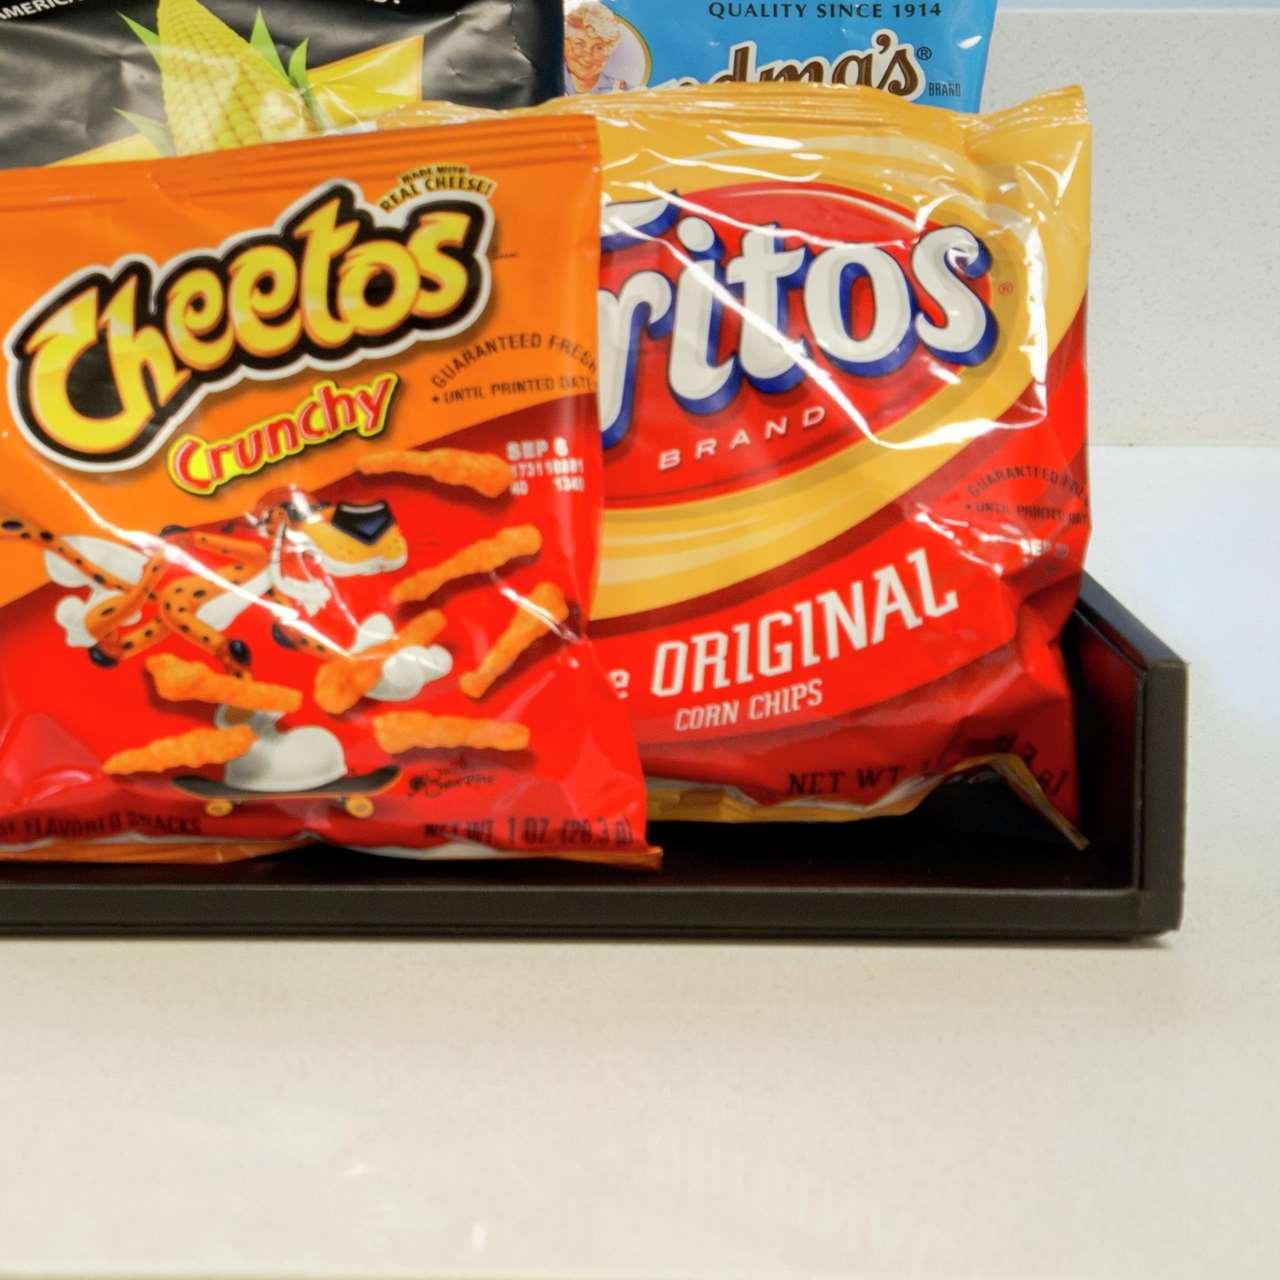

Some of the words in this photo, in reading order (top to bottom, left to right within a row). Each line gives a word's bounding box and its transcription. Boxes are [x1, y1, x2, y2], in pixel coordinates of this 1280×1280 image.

[708, 1, 808, 20] QUALITY
[815, 1, 884, 19] SINCE
[891, 0, 943, 18] 1914
[928, 81, 962, 97] BRAND
[379, 184, 422, 212] REAL
[424, 176, 494, 196] CHEESE!
[20, 184, 480, 462] Cheetos
[600, 200, 998, 449] ritos
[431, 333, 542, 389] GUARANTEED
[443, 385, 484, 404] UNTIL
[491, 377, 555, 396] PRINTED
[171, 377, 395, 491] Crunchy
[659, 406, 826, 471] BRAND
[651, 547, 958, 698] ORIGINAL
[673, 692, 739, 733] CORN
[748, 678, 824, 721] CHIPS
[787, 770, 846, 795] NET
[857, 766, 902, 788] WT
[523, 816, 552, 844] OZ
